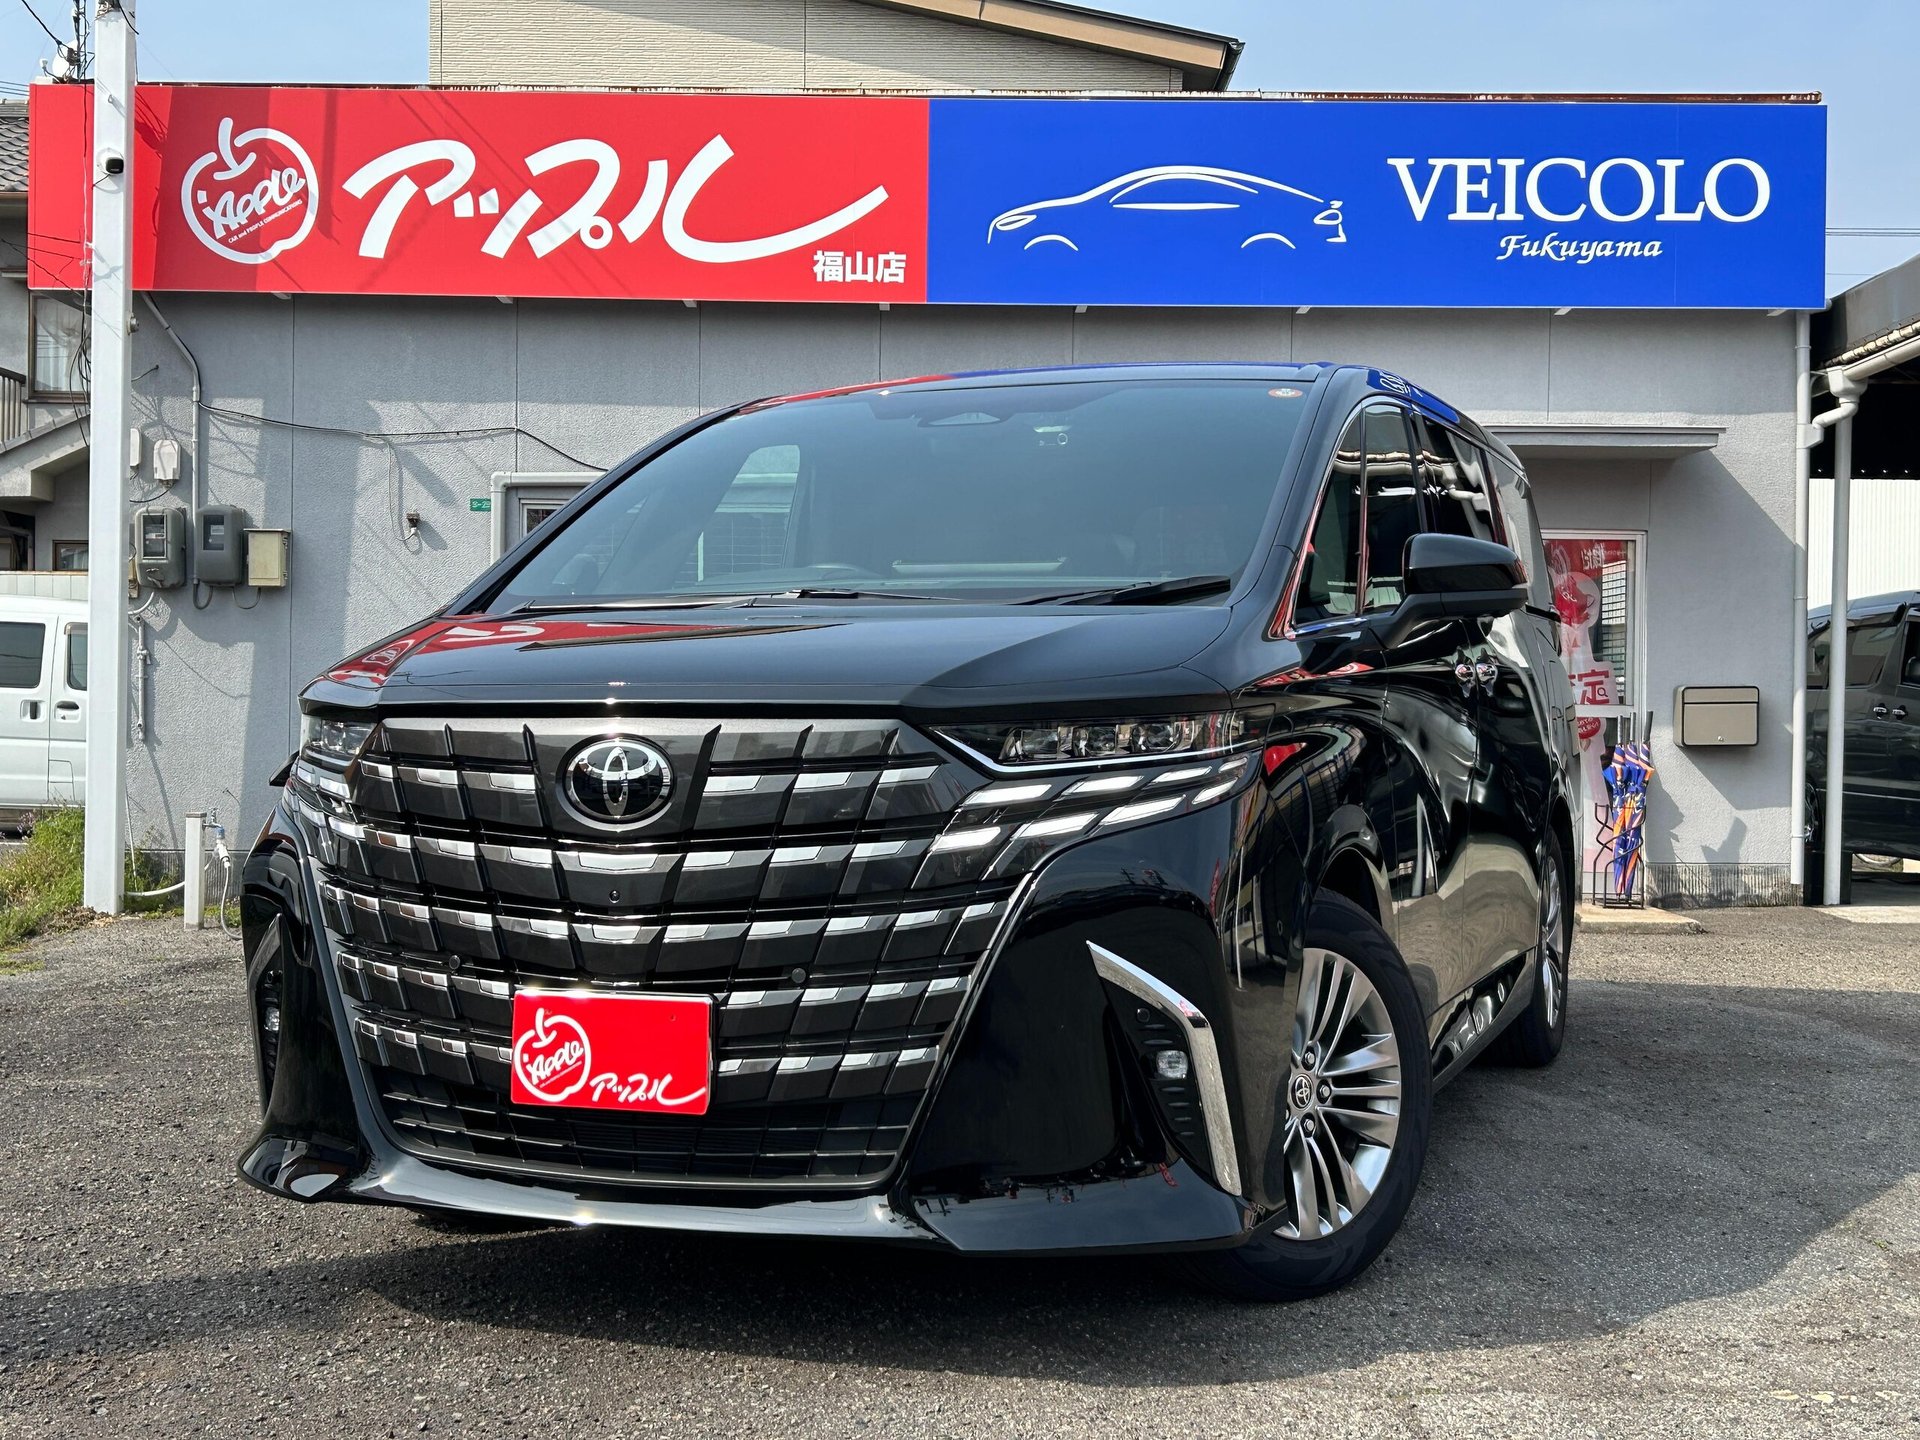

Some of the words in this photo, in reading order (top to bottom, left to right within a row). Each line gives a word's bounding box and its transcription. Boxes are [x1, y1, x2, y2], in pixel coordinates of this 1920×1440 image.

[342, 134, 889, 263] アップル
[1387, 157, 1770, 223] VEICOLO
[1496, 232, 1663, 265] Fukuyama
[813, 250, 907, 284] 福山店
[589, 1072, 707, 1106] アップル
